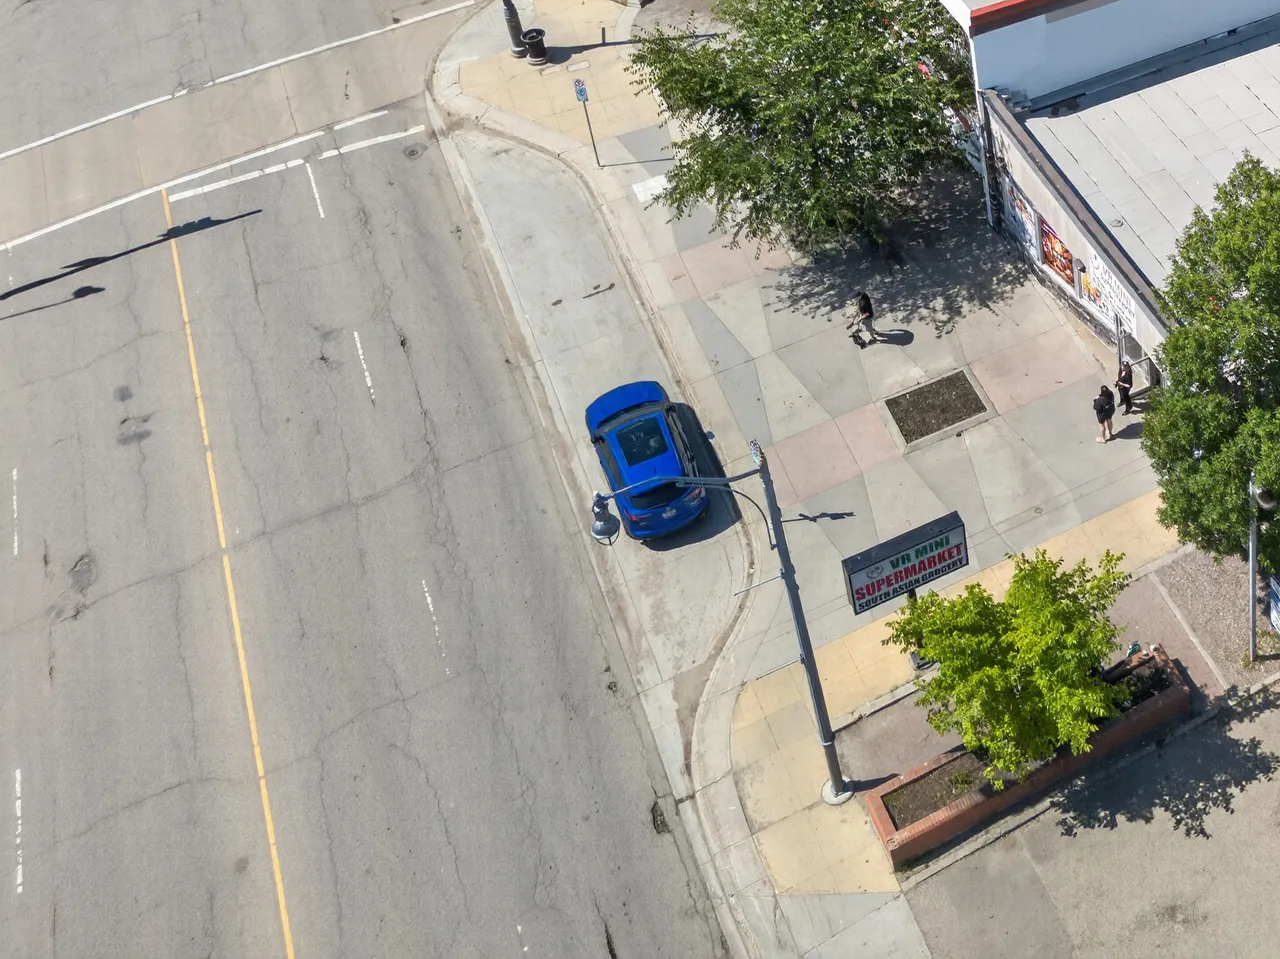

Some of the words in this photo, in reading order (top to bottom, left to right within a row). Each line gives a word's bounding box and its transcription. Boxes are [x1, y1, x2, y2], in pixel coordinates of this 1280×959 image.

[855, 542, 962, 601] SUPERMARKET
[889, 552, 911, 570] VR
[915, 535, 950, 559] MINI
[858, 590, 890, 611] SOUTH
[892, 576, 921, 596] ASIAN
[921, 557, 964, 582] GROCERY
